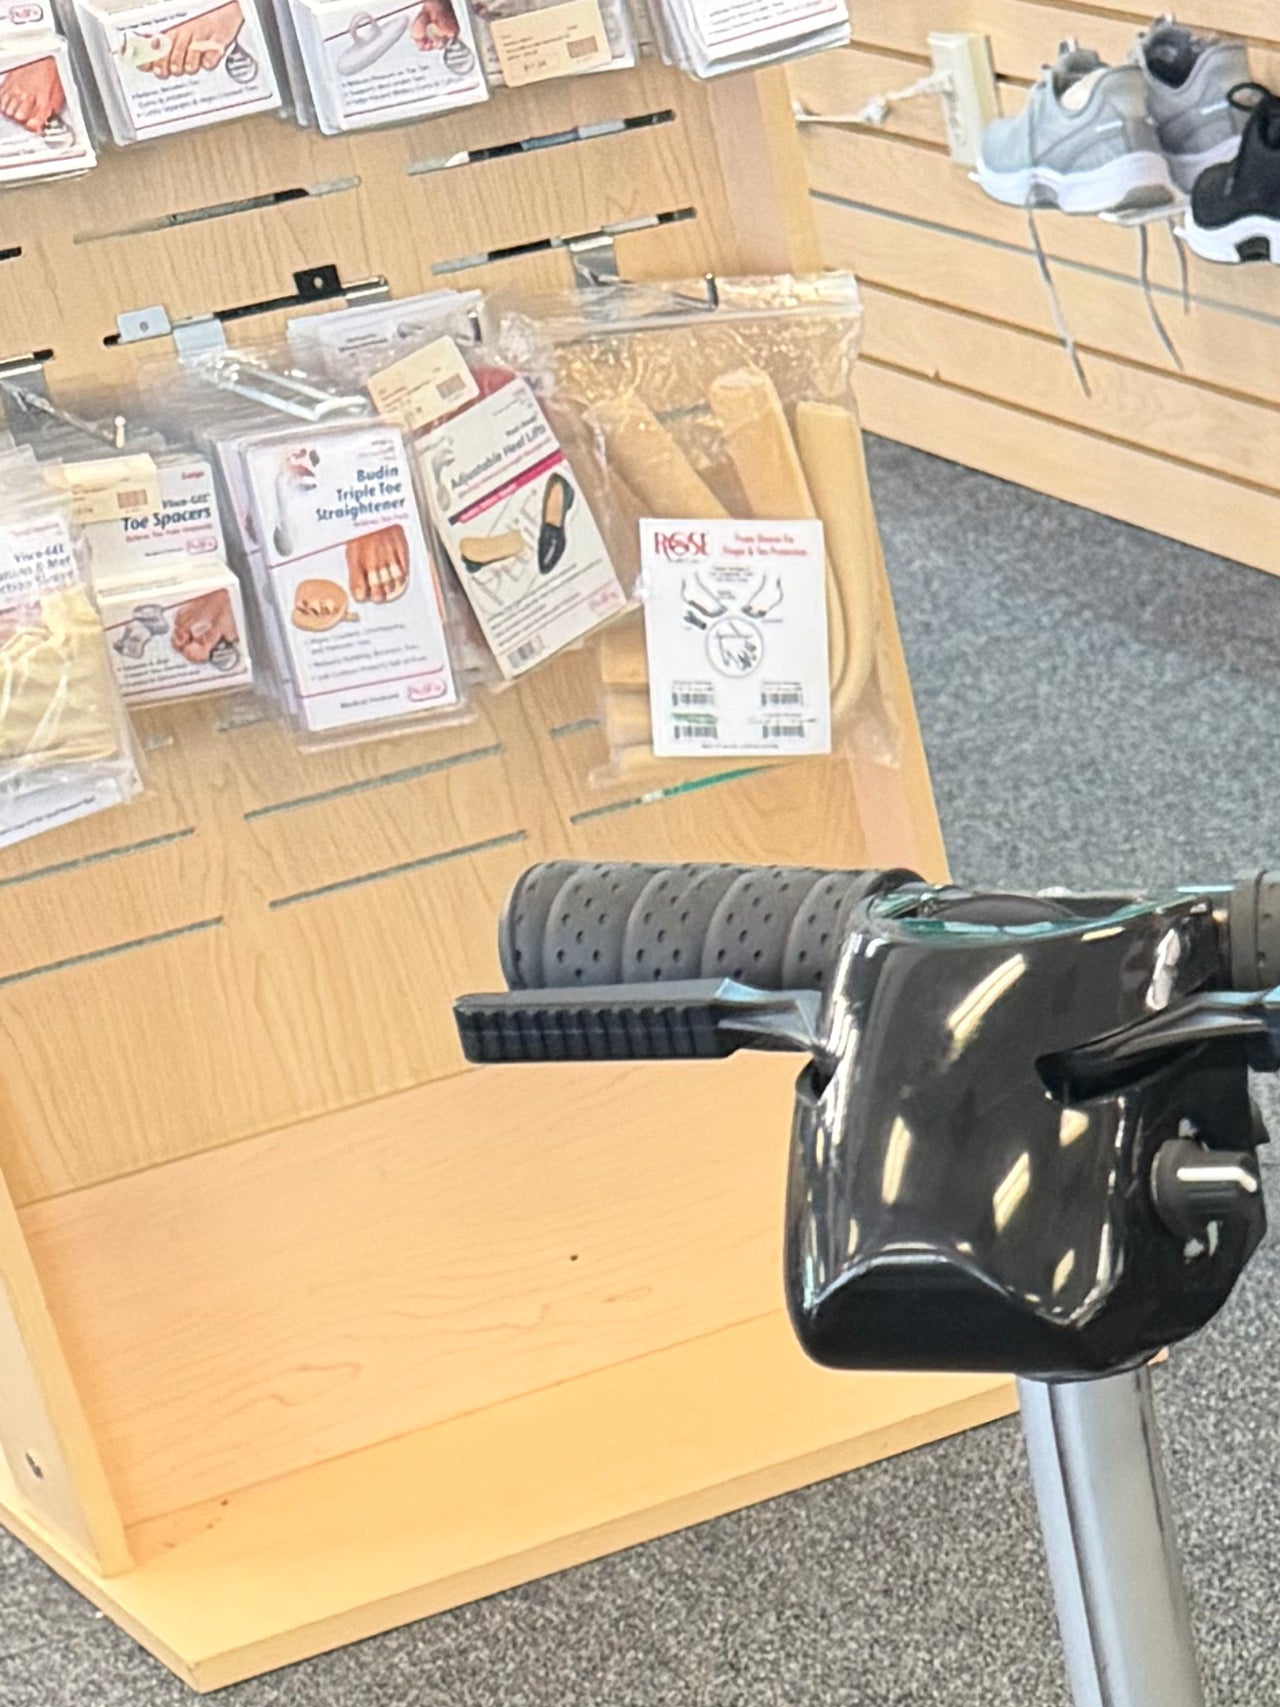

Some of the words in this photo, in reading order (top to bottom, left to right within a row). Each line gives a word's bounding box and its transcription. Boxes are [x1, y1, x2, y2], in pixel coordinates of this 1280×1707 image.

[356, 465, 399, 483] Budin
[451, 453, 502, 489] Adjustable
[337, 485, 375, 504] Triple
[379, 482, 402, 498] Toe
[122, 516, 149, 532] Toe
[153, 507, 211, 530] Spacers
[316, 497, 406, 521] Straightener
